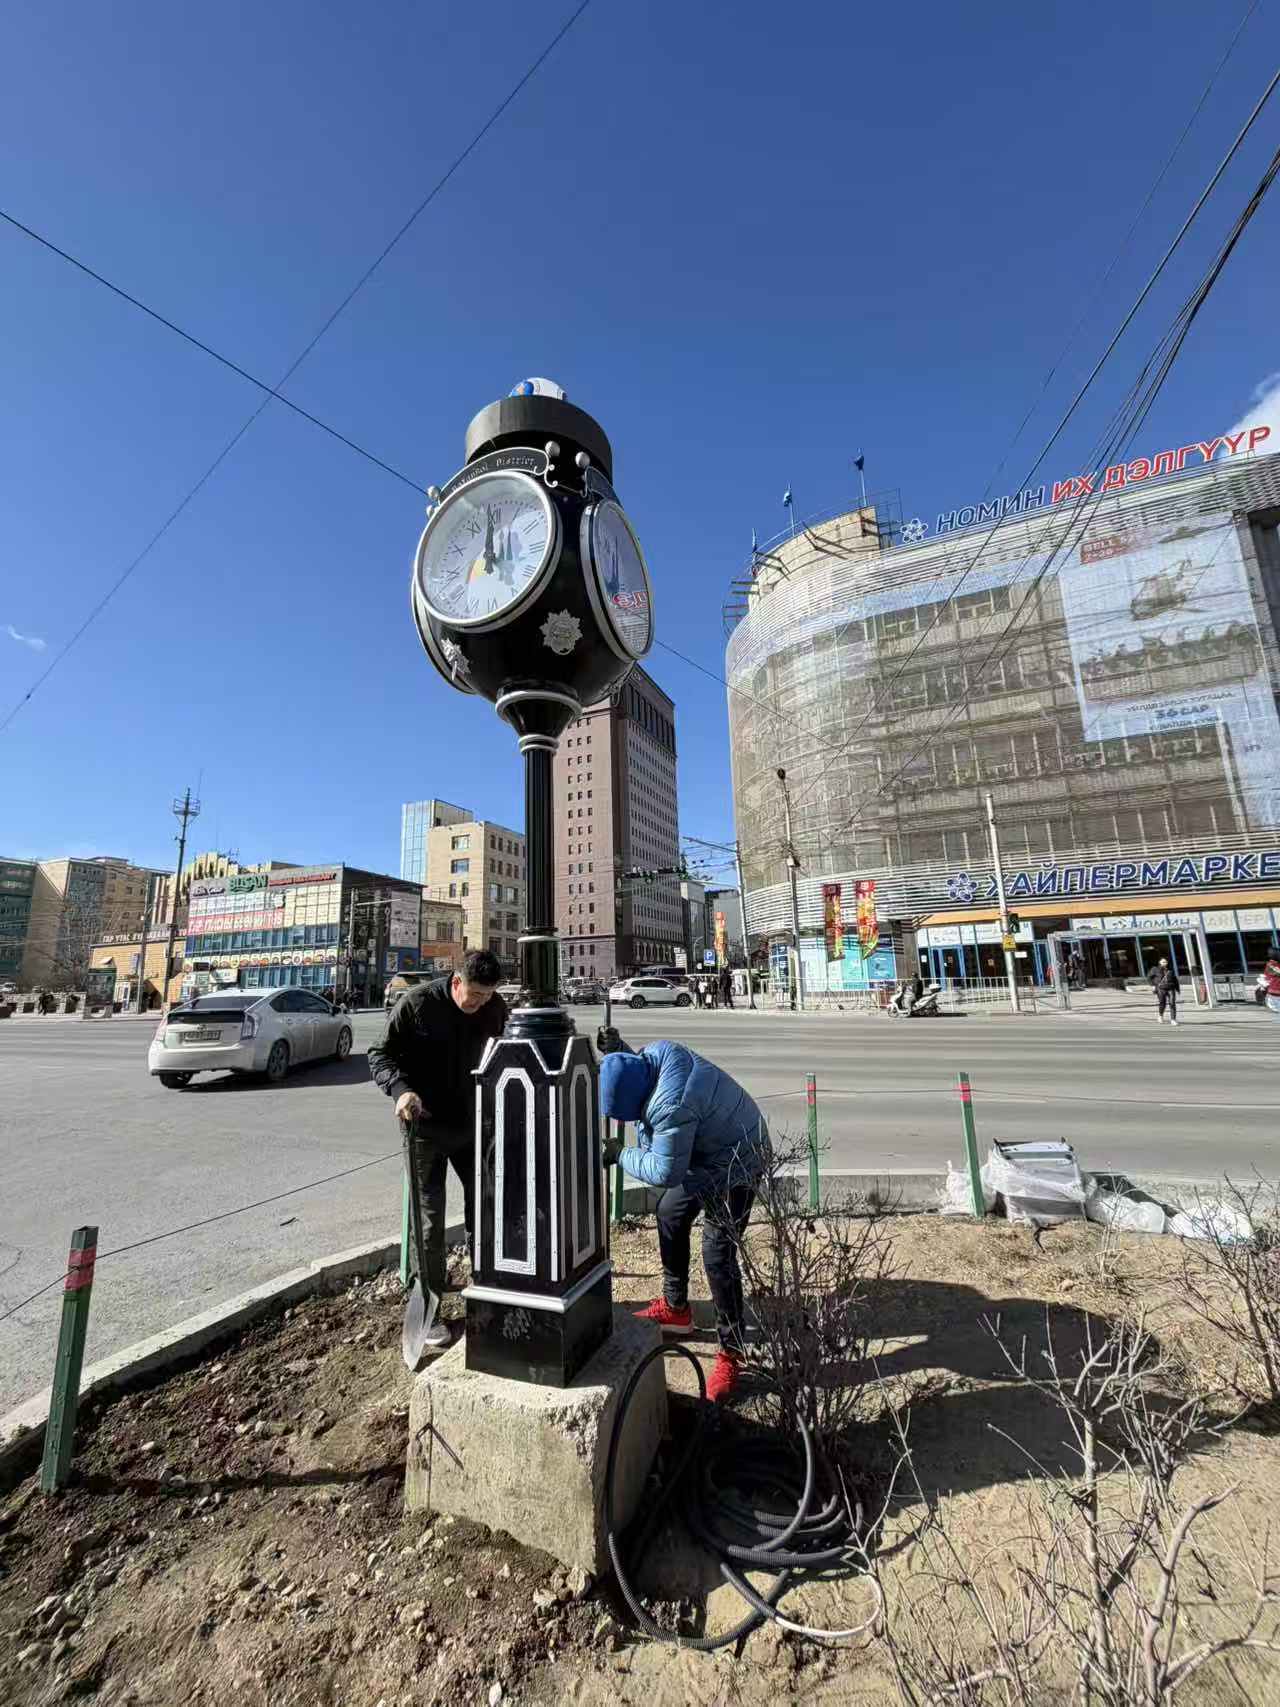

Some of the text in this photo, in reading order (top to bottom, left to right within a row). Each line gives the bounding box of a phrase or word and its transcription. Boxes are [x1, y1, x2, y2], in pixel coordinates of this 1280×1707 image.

[936, 425, 1272, 533] НОМИН ИХ ДЭЛГҮҮР
